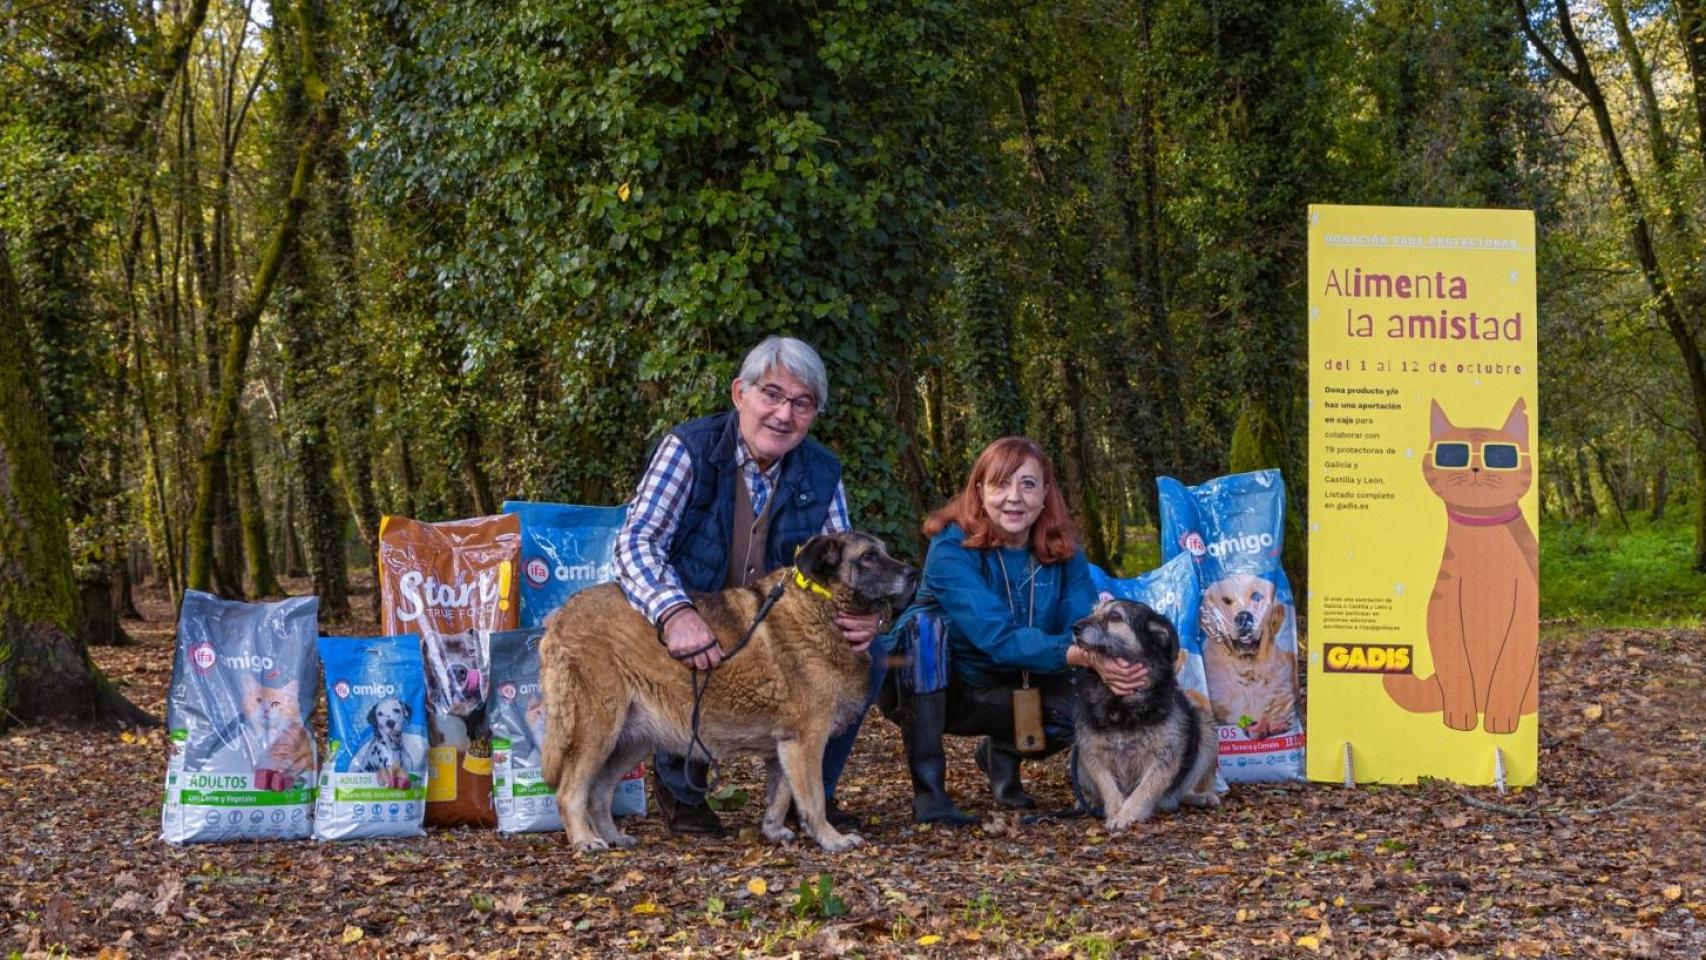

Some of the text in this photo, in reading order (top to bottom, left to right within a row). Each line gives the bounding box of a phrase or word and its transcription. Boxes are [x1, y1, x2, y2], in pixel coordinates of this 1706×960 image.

[1324, 267, 1467, 300] Alimenta
[1347, 308, 1522, 341] la amistad
[1324, 358, 1521, 374] del 1 al 12 de octubre
[1324, 386, 1399, 396] Dona producto y/o
[1324, 401, 1339, 409] haz
[1358, 402, 1402, 411] aportación
[1336, 416, 1353, 425] caja
[1324, 431, 1363, 439] colaborar
[1336, 446, 1384, 455] protectoras
[1386, 447, 1396, 455] de
[1324, 460, 1352, 468] Galicia
[1324, 476, 1355, 484] Castilla
[1324, 491, 1395, 500] Listado completo
[1336, 501, 1369, 511] gadis.es
[1207, 531, 1273, 557] amigo
[555, 561, 612, 583] amig
[1327, 646, 1410, 671] GADIS
[352, 682, 395, 698] amigo
[190, 774, 248, 789] ADULTOS
